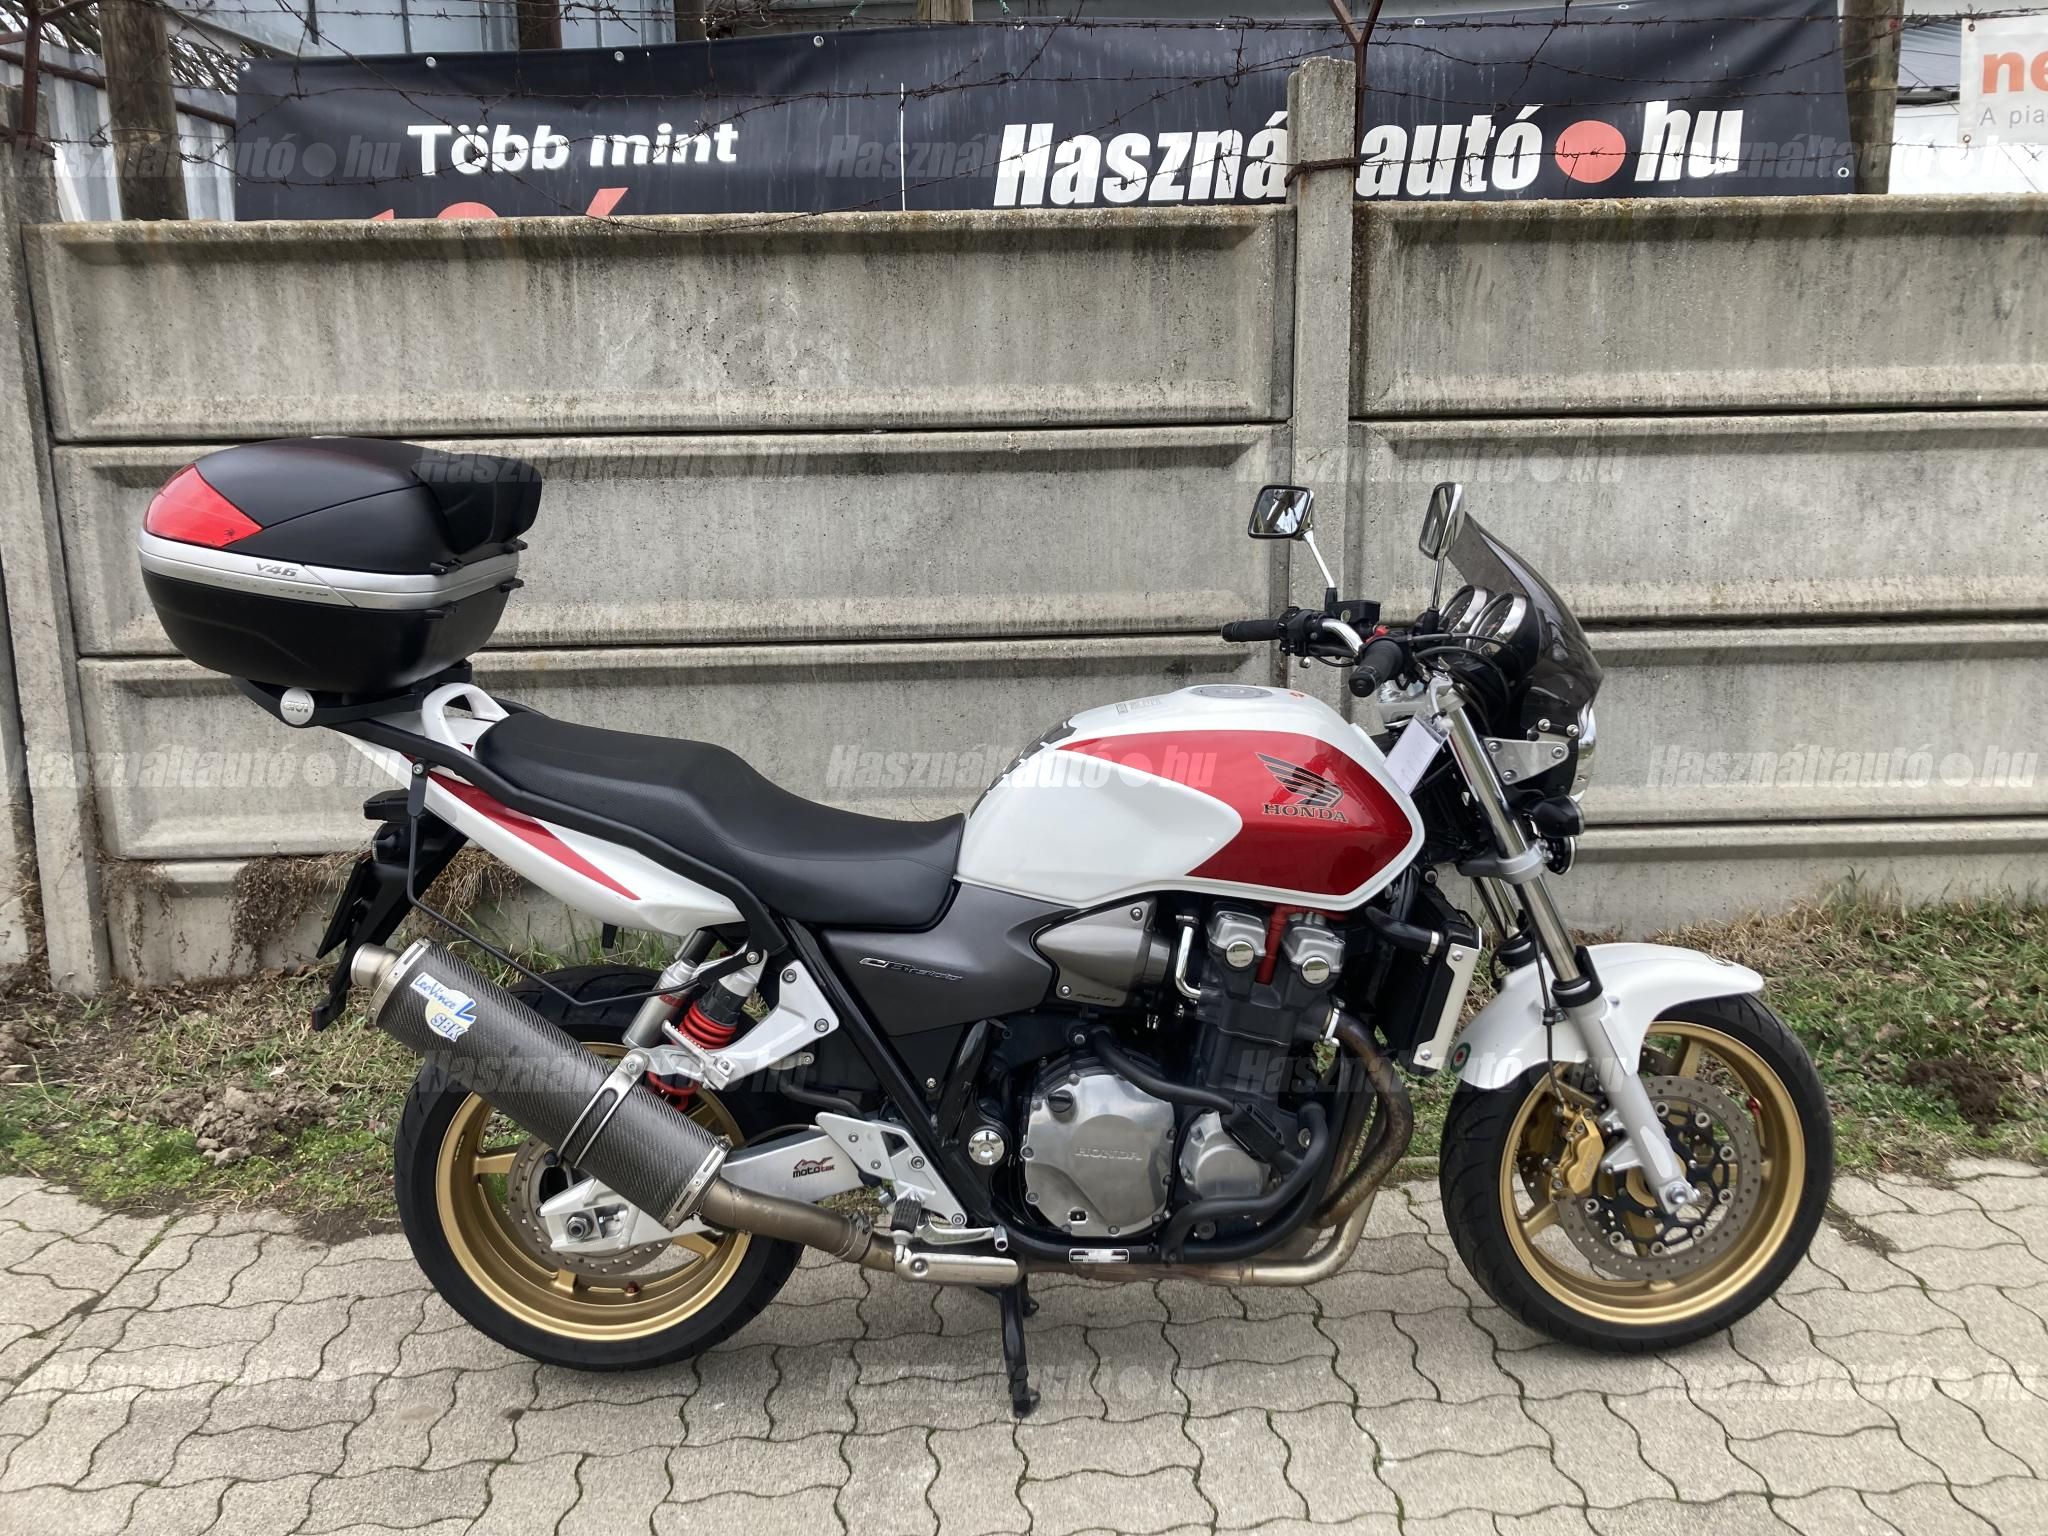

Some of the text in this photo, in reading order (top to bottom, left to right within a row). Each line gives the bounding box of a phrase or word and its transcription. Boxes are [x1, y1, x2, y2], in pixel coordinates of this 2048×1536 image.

[1979, 105, 2048, 128] A pia
[407, 123, 738, 176] Több mint
[256, 563, 298, 576] V46
[1263, 803, 1349, 824] HONDA
[430, 1013, 466, 1041] SBK
